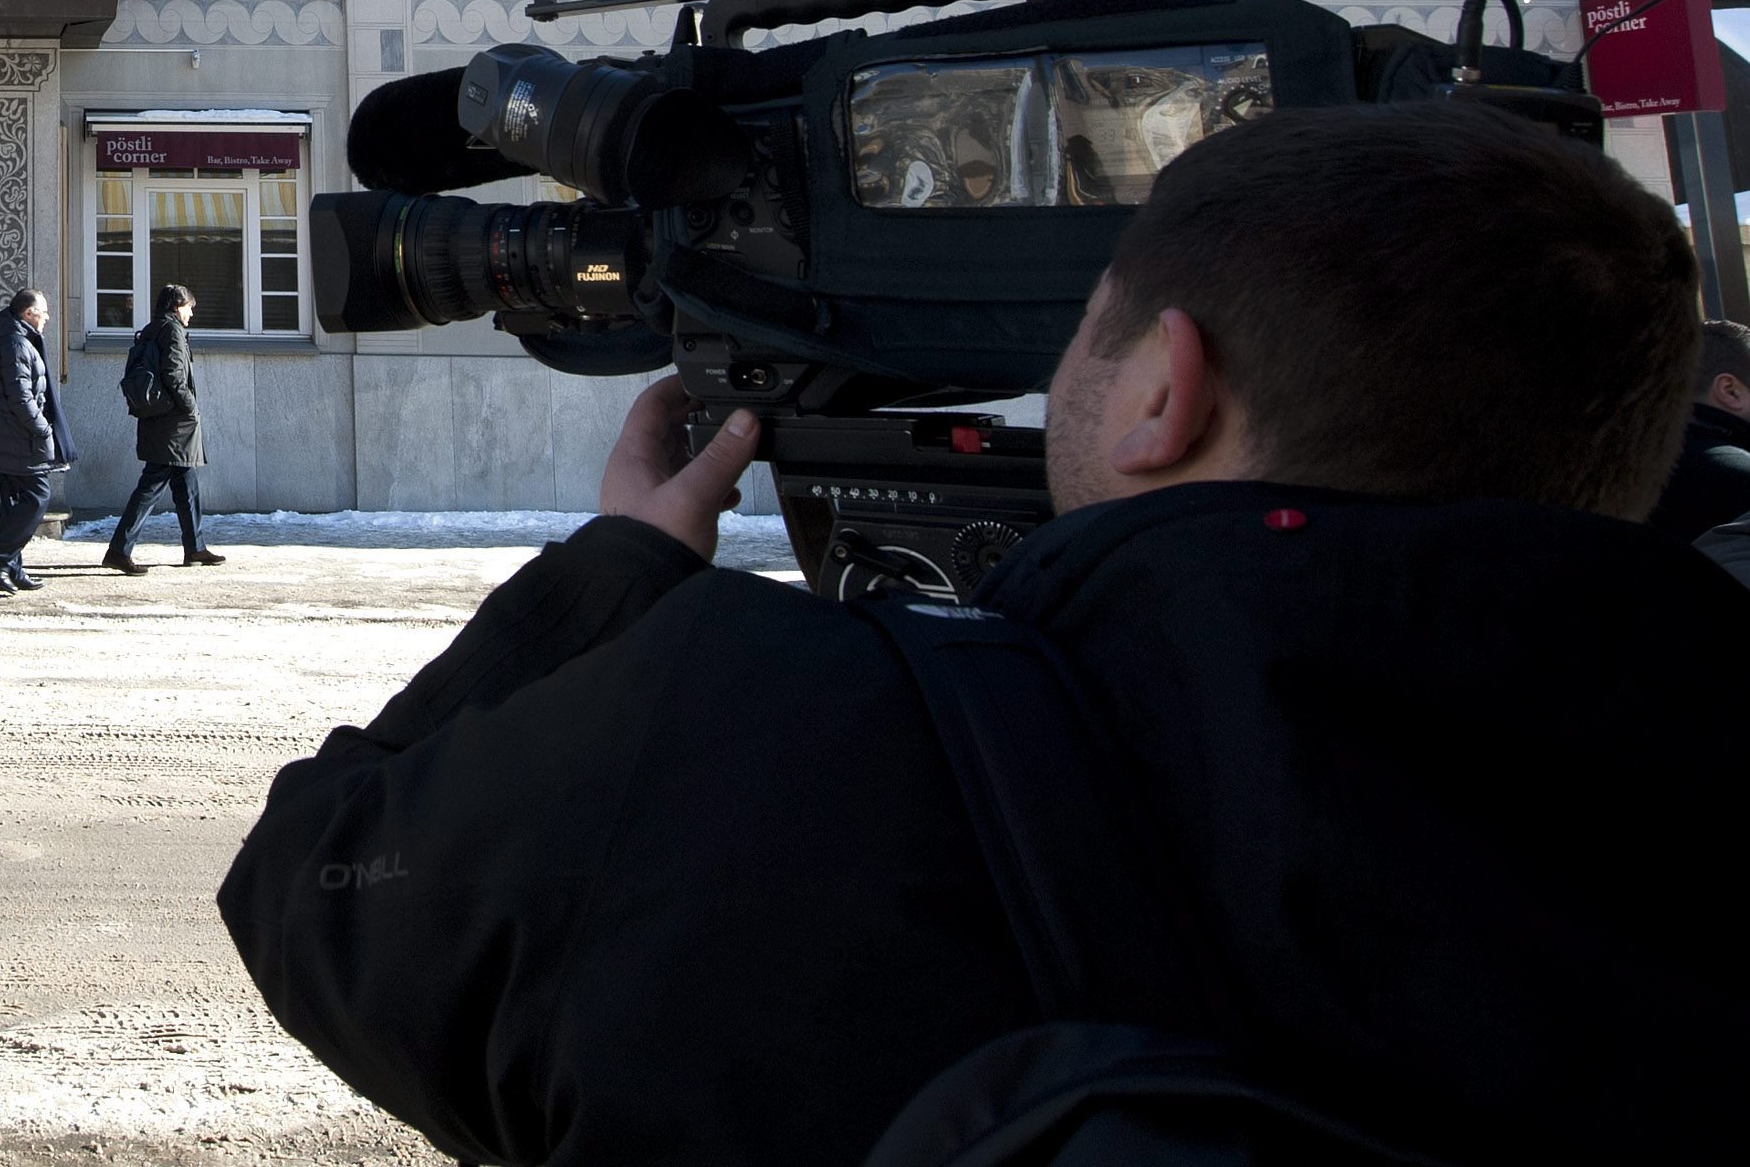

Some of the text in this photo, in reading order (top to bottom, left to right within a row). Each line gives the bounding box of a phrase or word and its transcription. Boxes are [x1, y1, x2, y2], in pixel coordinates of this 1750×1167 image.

[1587, 0, 1630, 29] pöstli
[1639, 98, 1658, 108] Take
[1660, 97, 1681, 107] Away
[107, 135, 152, 155] pöstli
[113, 151, 167, 163] corner
[250, 156, 269, 165] Take
[271, 156, 292, 167] Away
[587, 264, 609, 273] HD
[576, 271, 620, 282] FUJINON
[908, 491, 918, 500] 10
